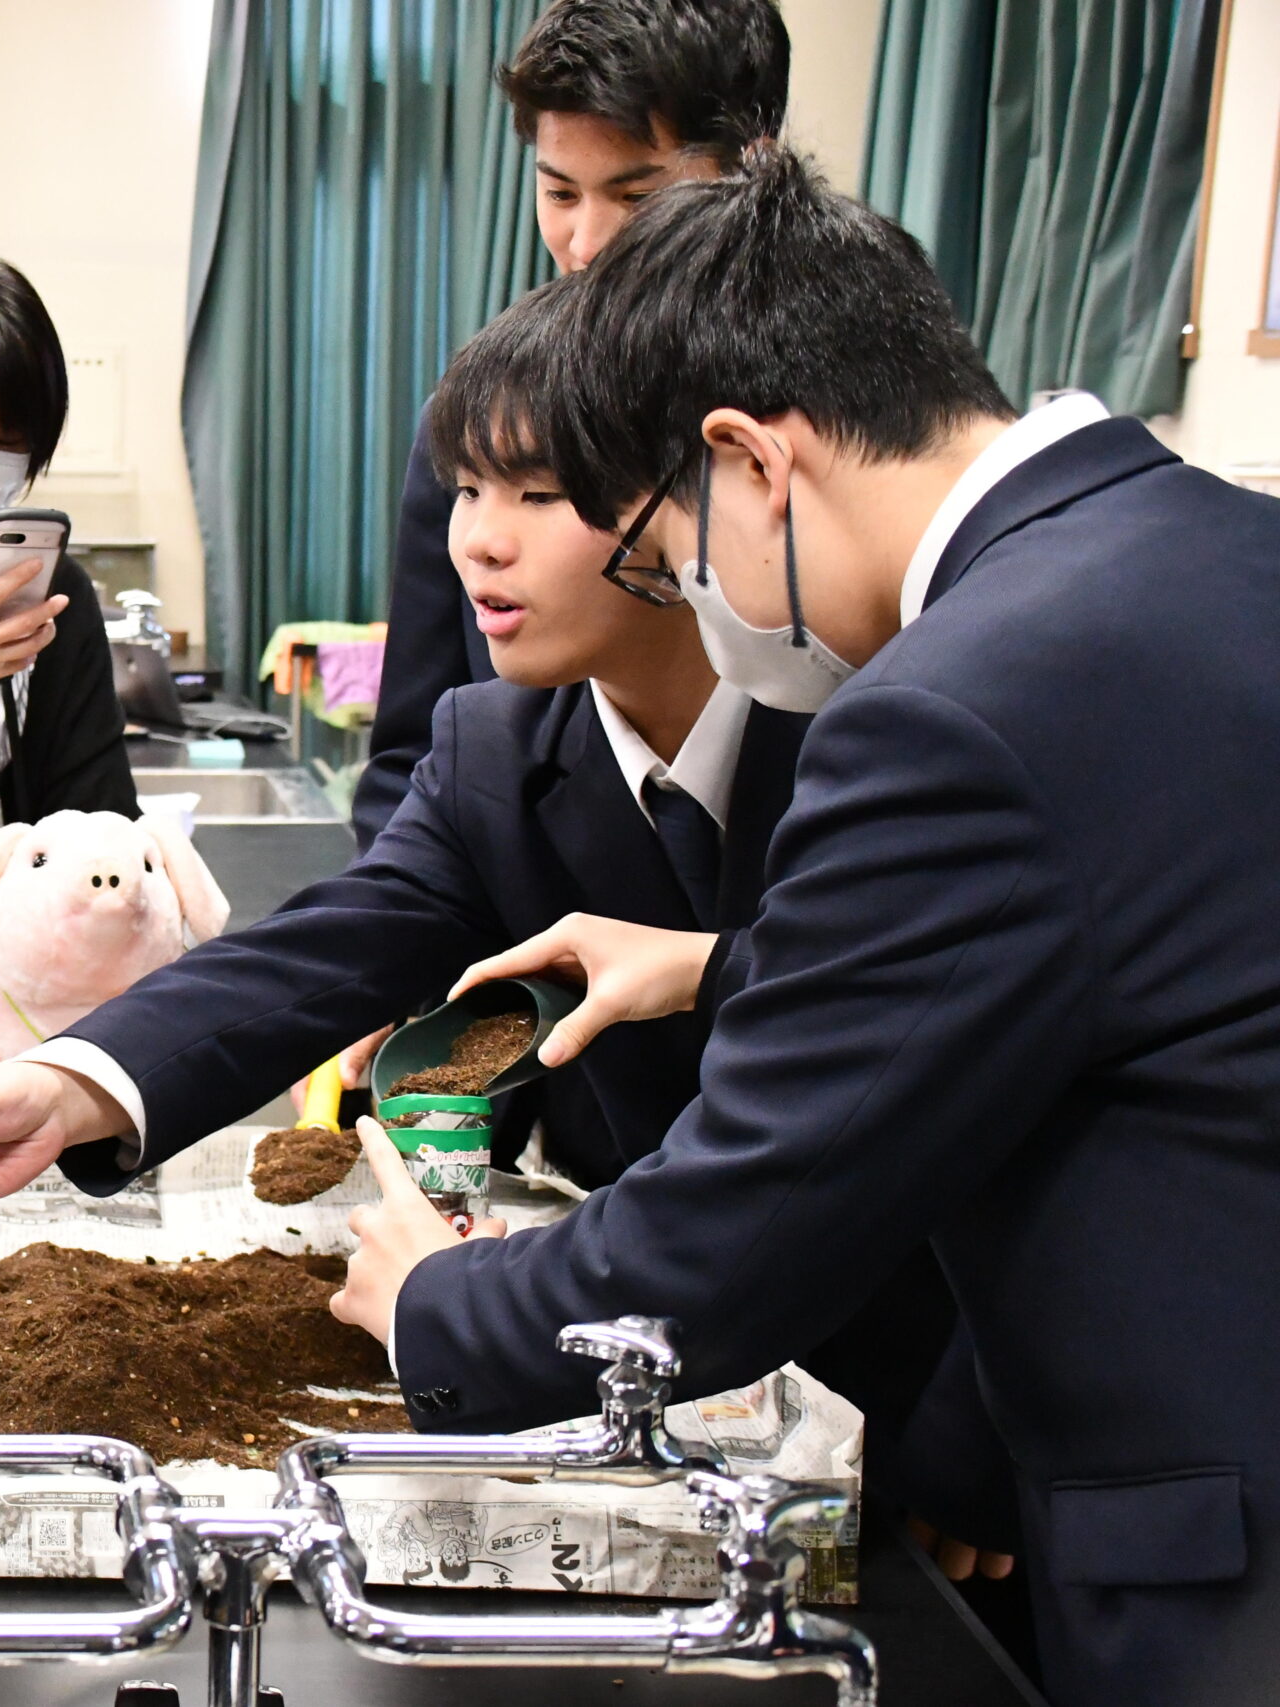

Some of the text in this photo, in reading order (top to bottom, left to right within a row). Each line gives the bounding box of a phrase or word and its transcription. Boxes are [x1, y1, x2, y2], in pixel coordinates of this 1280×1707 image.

[490, 1528, 545, 1551] ウコン配合
